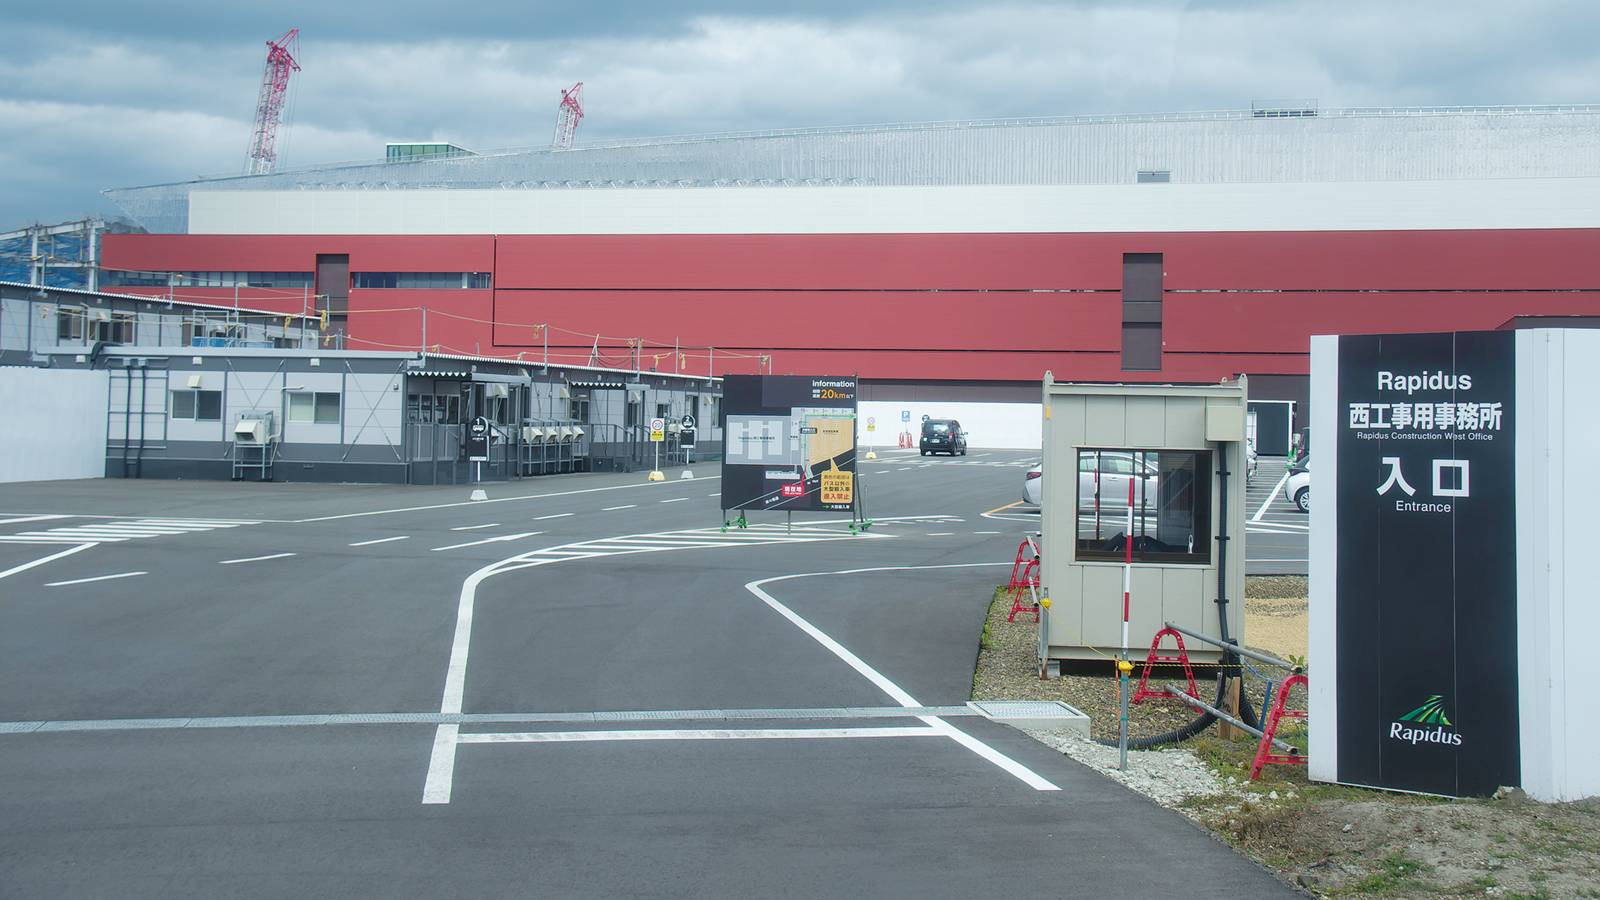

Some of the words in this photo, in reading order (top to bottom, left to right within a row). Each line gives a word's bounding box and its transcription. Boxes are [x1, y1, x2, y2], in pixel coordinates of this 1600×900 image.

[1378, 371, 1472, 395] Rapidus
[1349, 402, 1502, 431] 西工事用事務所
[1357, 432, 1389, 441] Rapidus
[1391, 432, 1442, 440] Construction
[1444, 432, 1465, 441] West
[1468, 433, 1493, 441] Office
[1376, 457, 1470, 497] 入口
[1396, 500, 1452, 513] Entrance
[1390, 722, 1462, 746] Rapidus
